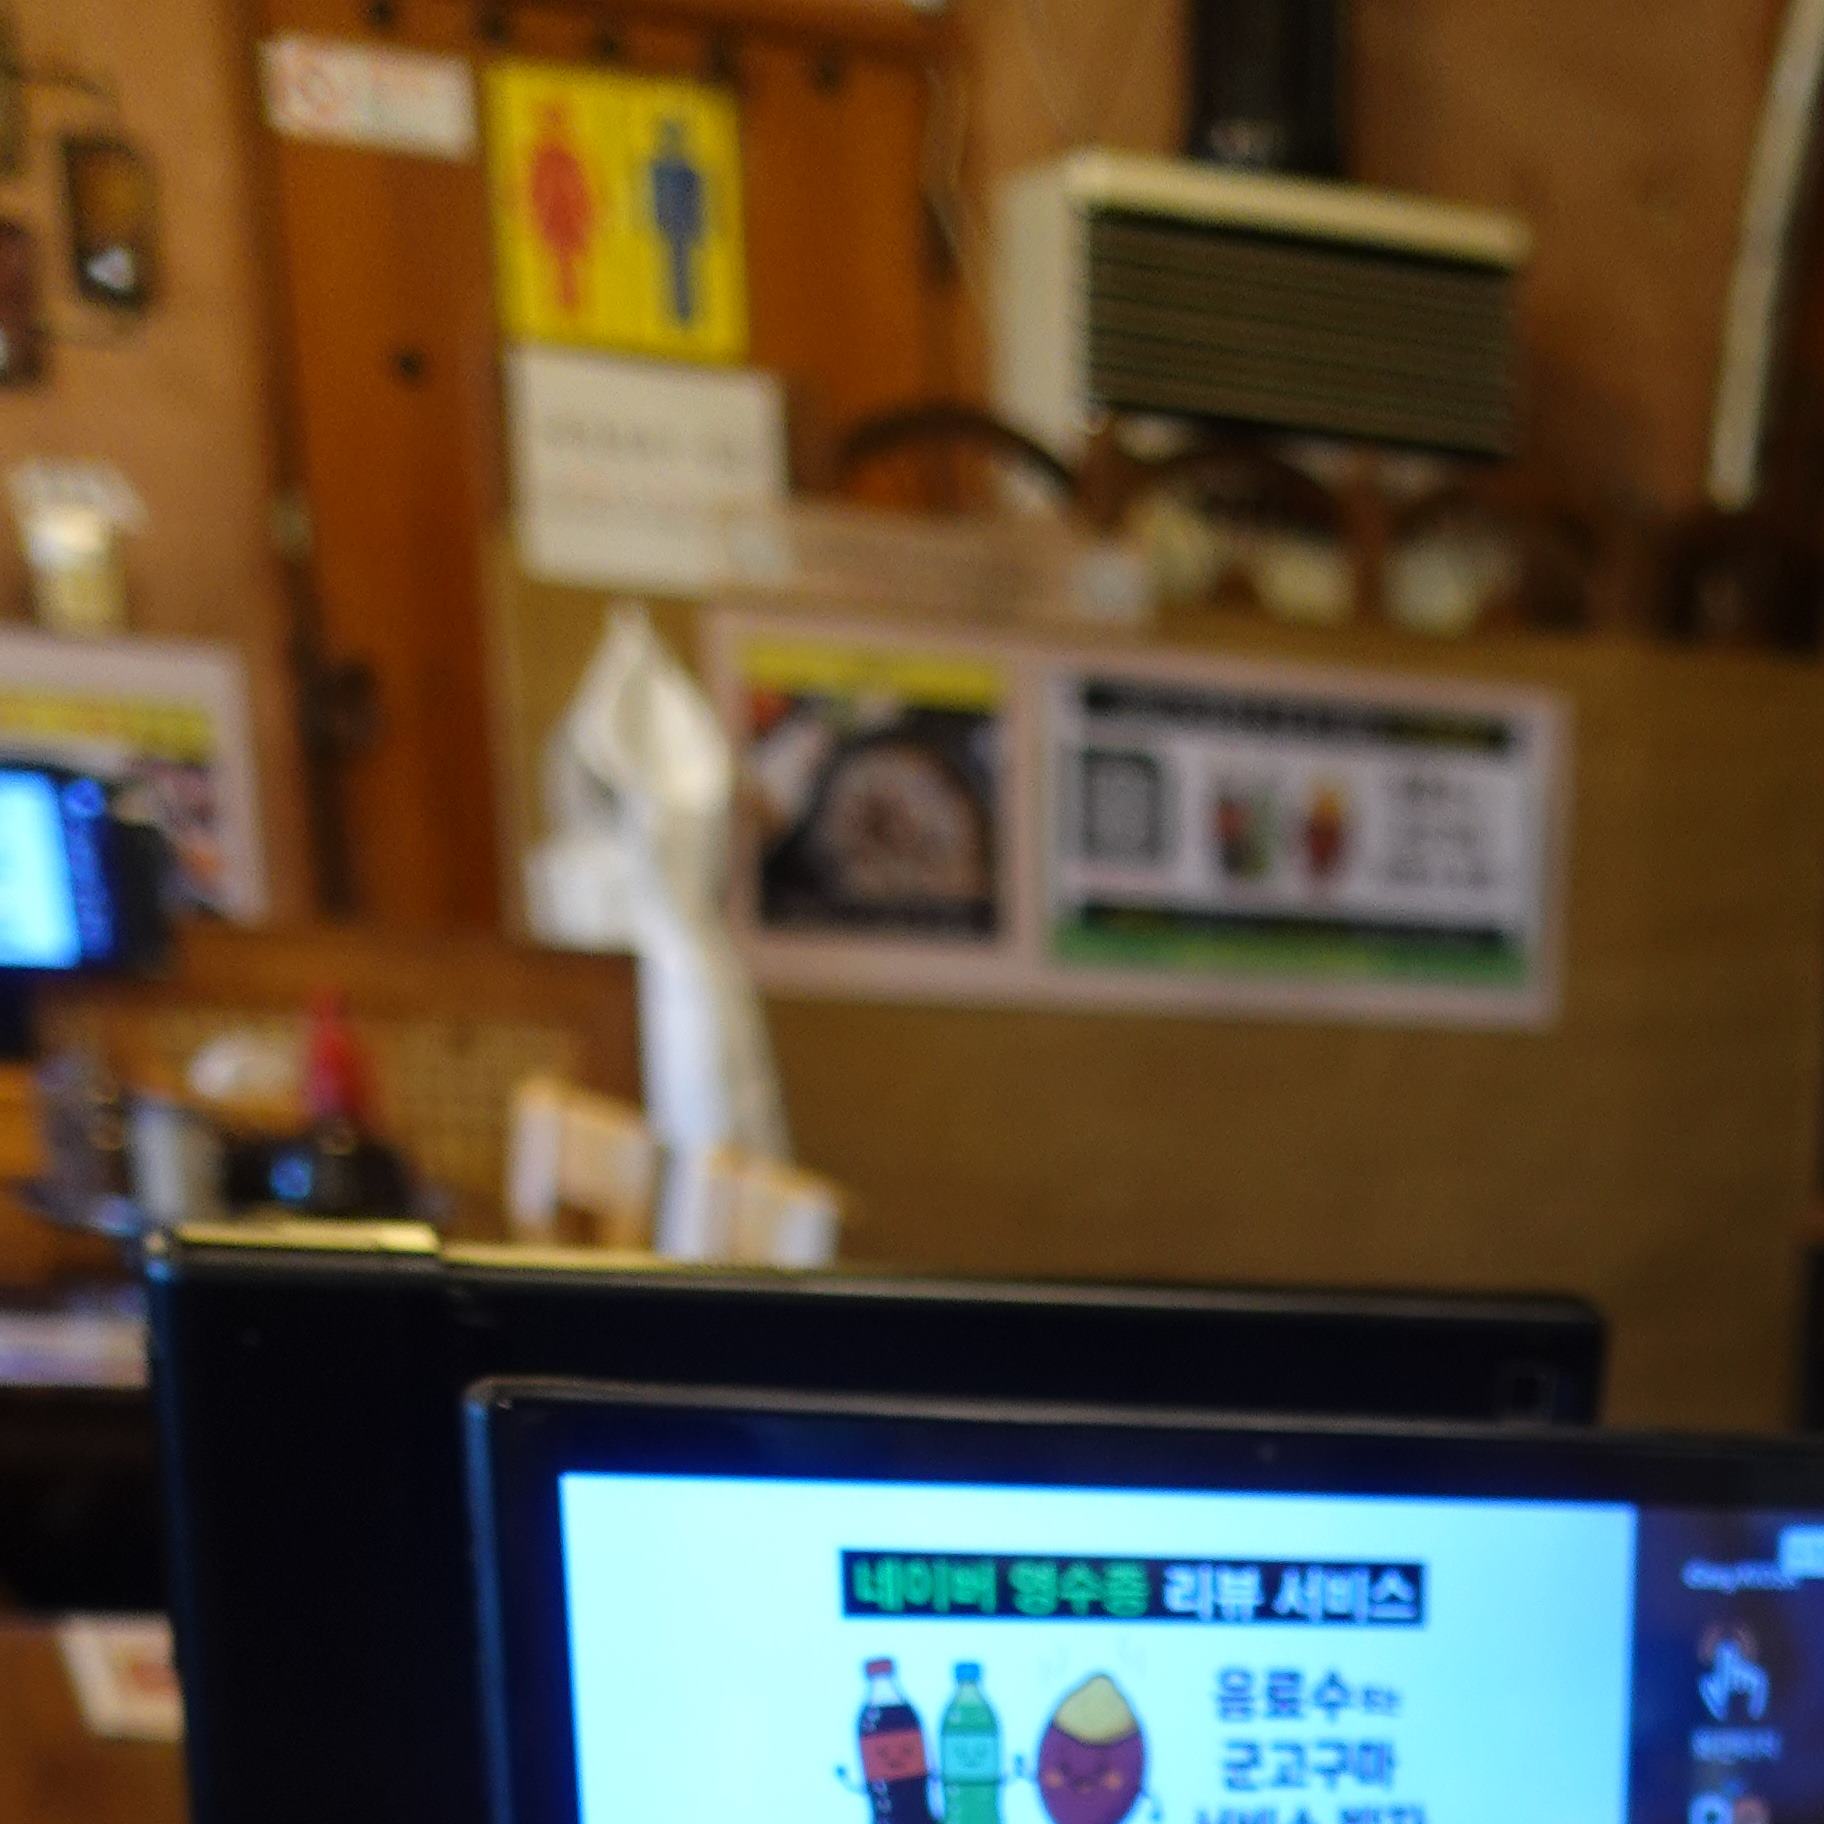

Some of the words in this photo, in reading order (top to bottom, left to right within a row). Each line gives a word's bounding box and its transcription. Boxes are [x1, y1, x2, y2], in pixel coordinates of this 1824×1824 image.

[1162, 1564, 1264, 1622] 리뷰
[1271, 1565, 1418, 1622] 서비스
[1215, 1667, 1355, 1722] 음료수
[1223, 1740, 1397, 1793] 군고구마
